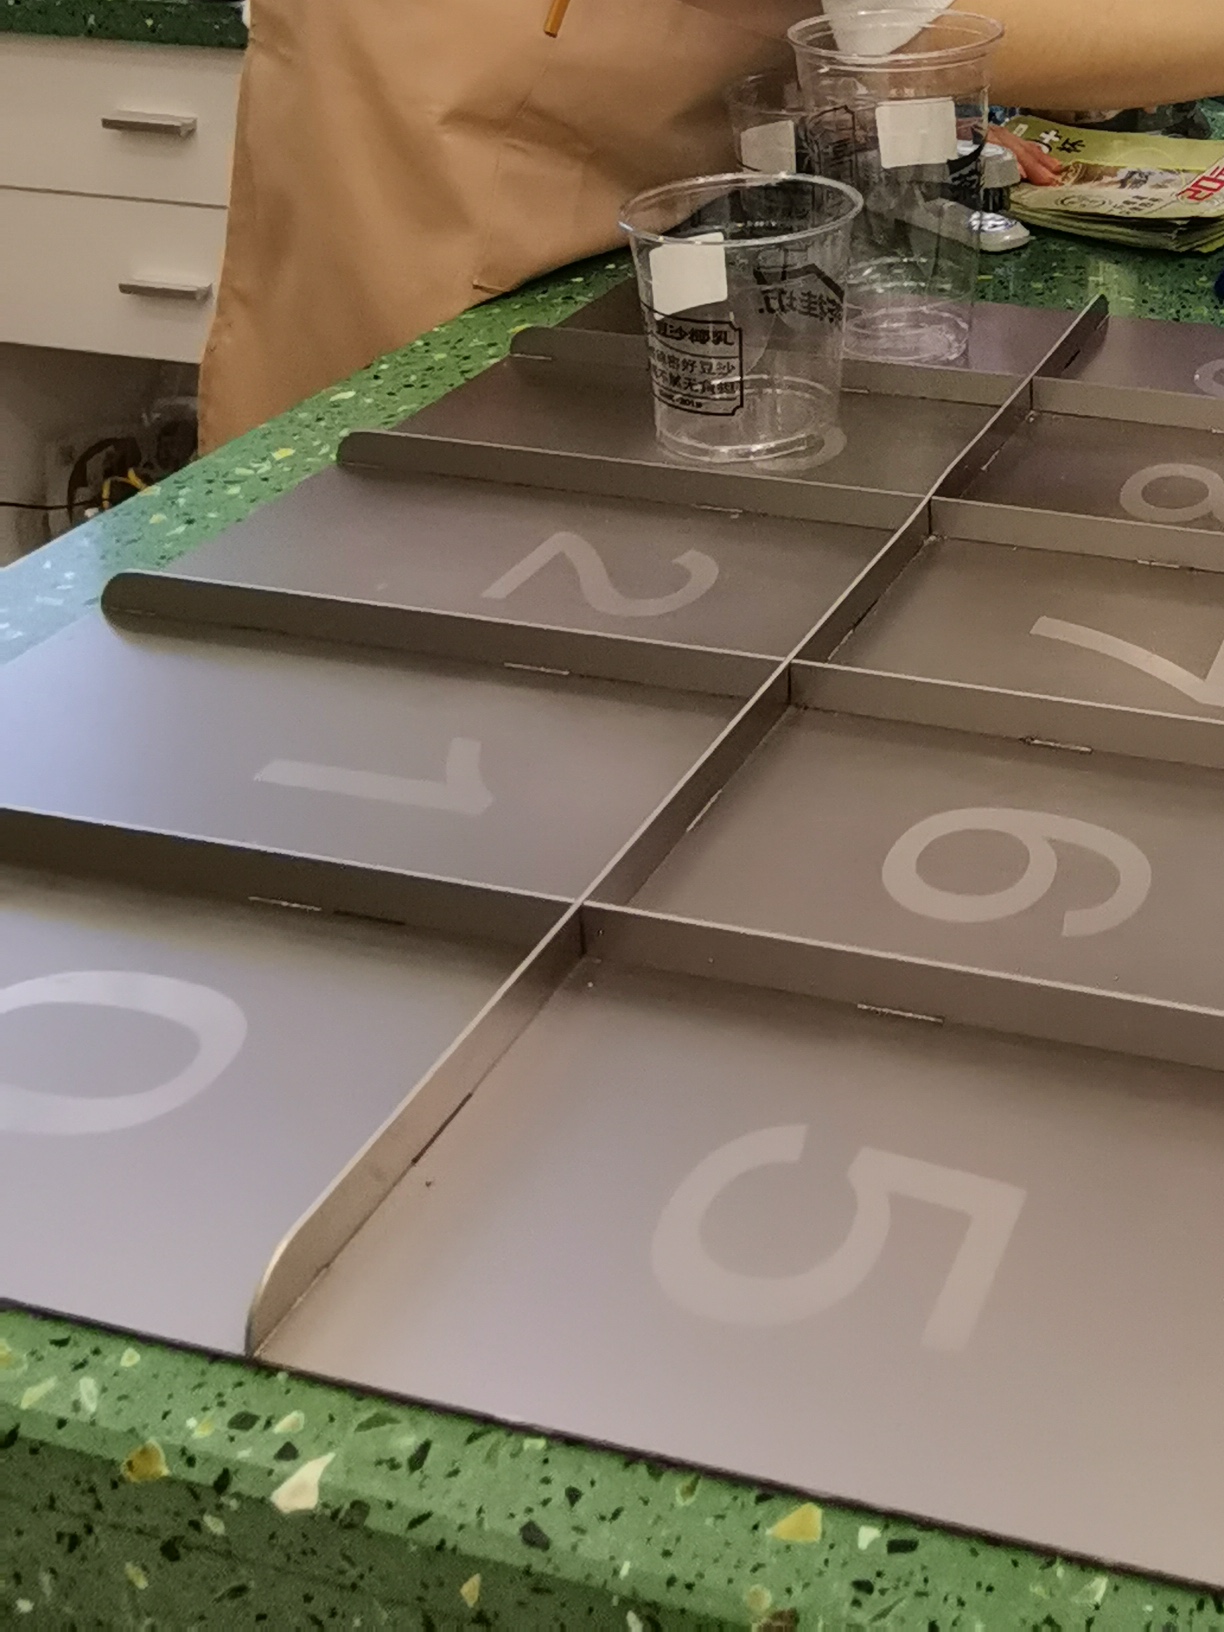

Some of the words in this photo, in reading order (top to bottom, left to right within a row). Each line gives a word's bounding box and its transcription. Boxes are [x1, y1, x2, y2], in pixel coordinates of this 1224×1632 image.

[480, 531, 720, 618] 2
[252, 737, 496, 817] 1
[880, 806, 1152, 938] 6
[650, 1123, 1028, 1353] 5
